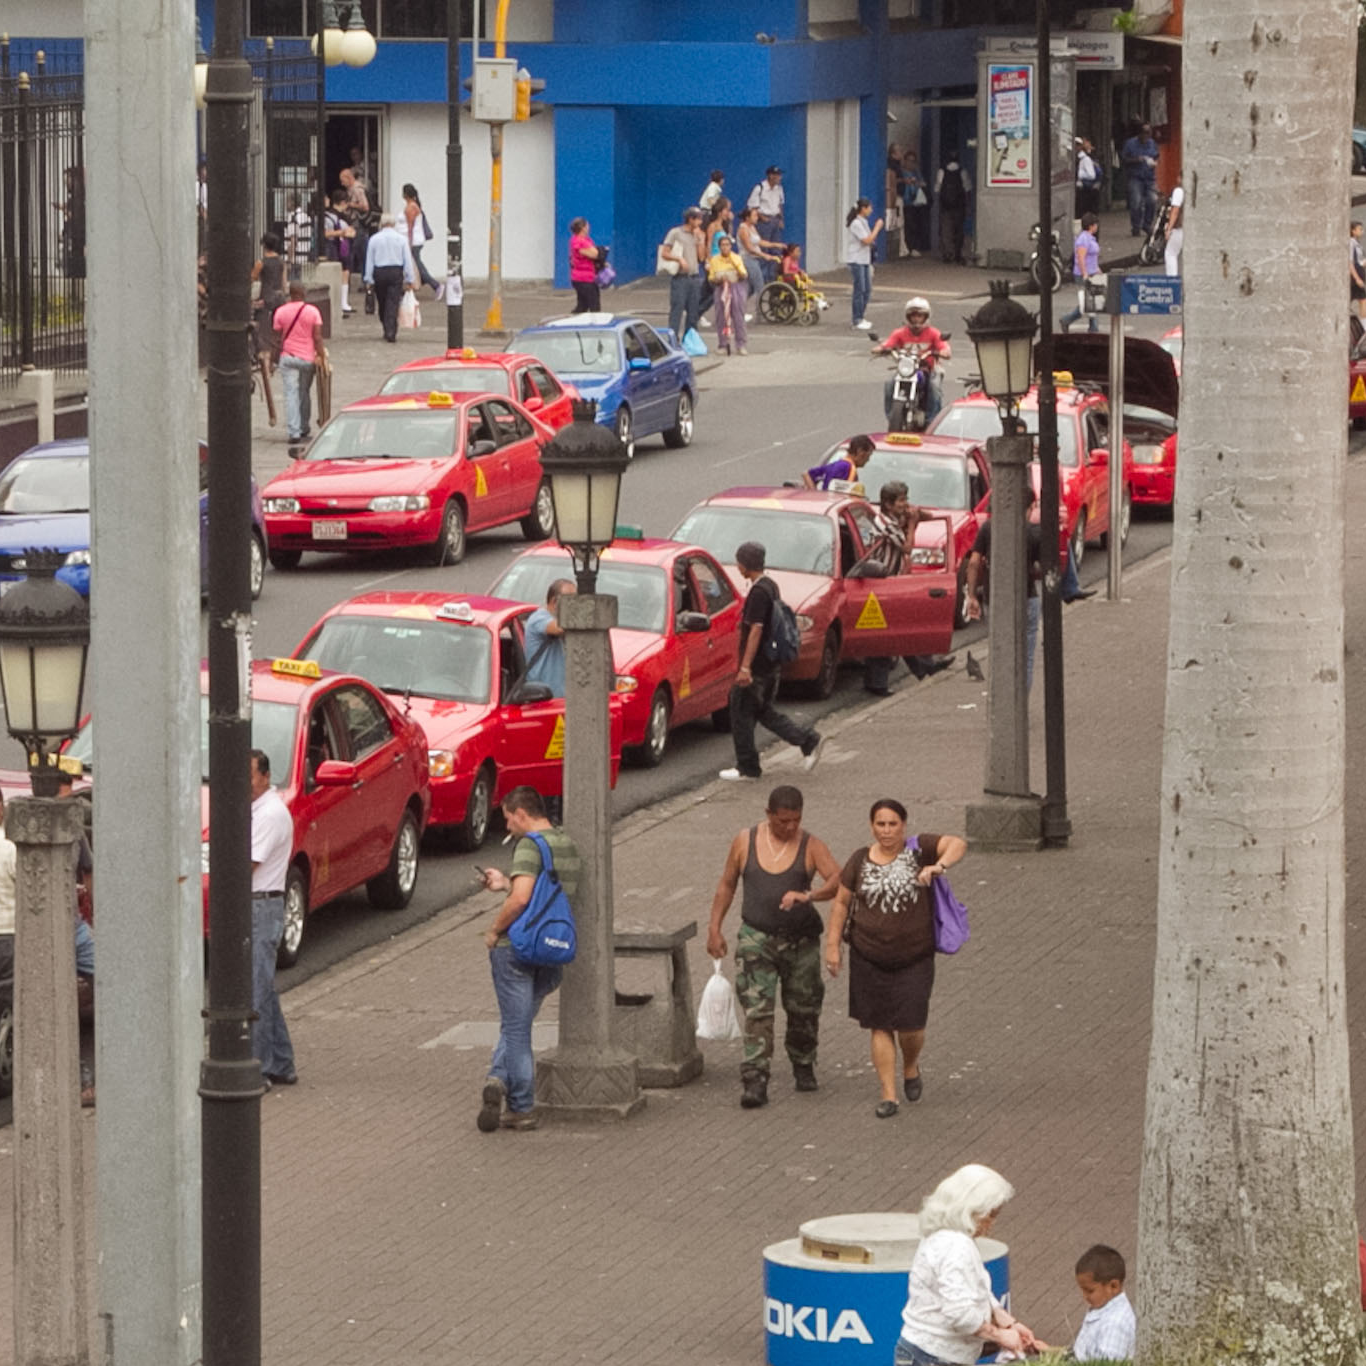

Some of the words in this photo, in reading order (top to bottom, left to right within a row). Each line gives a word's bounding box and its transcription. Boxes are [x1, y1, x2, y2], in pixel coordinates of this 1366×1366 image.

[1138, 283, 1174, 296] Parque
[1137, 294, 1174, 304] Central
[278, 660, 301, 673] TAXI
[765, 1297, 874, 1345] OKIA
